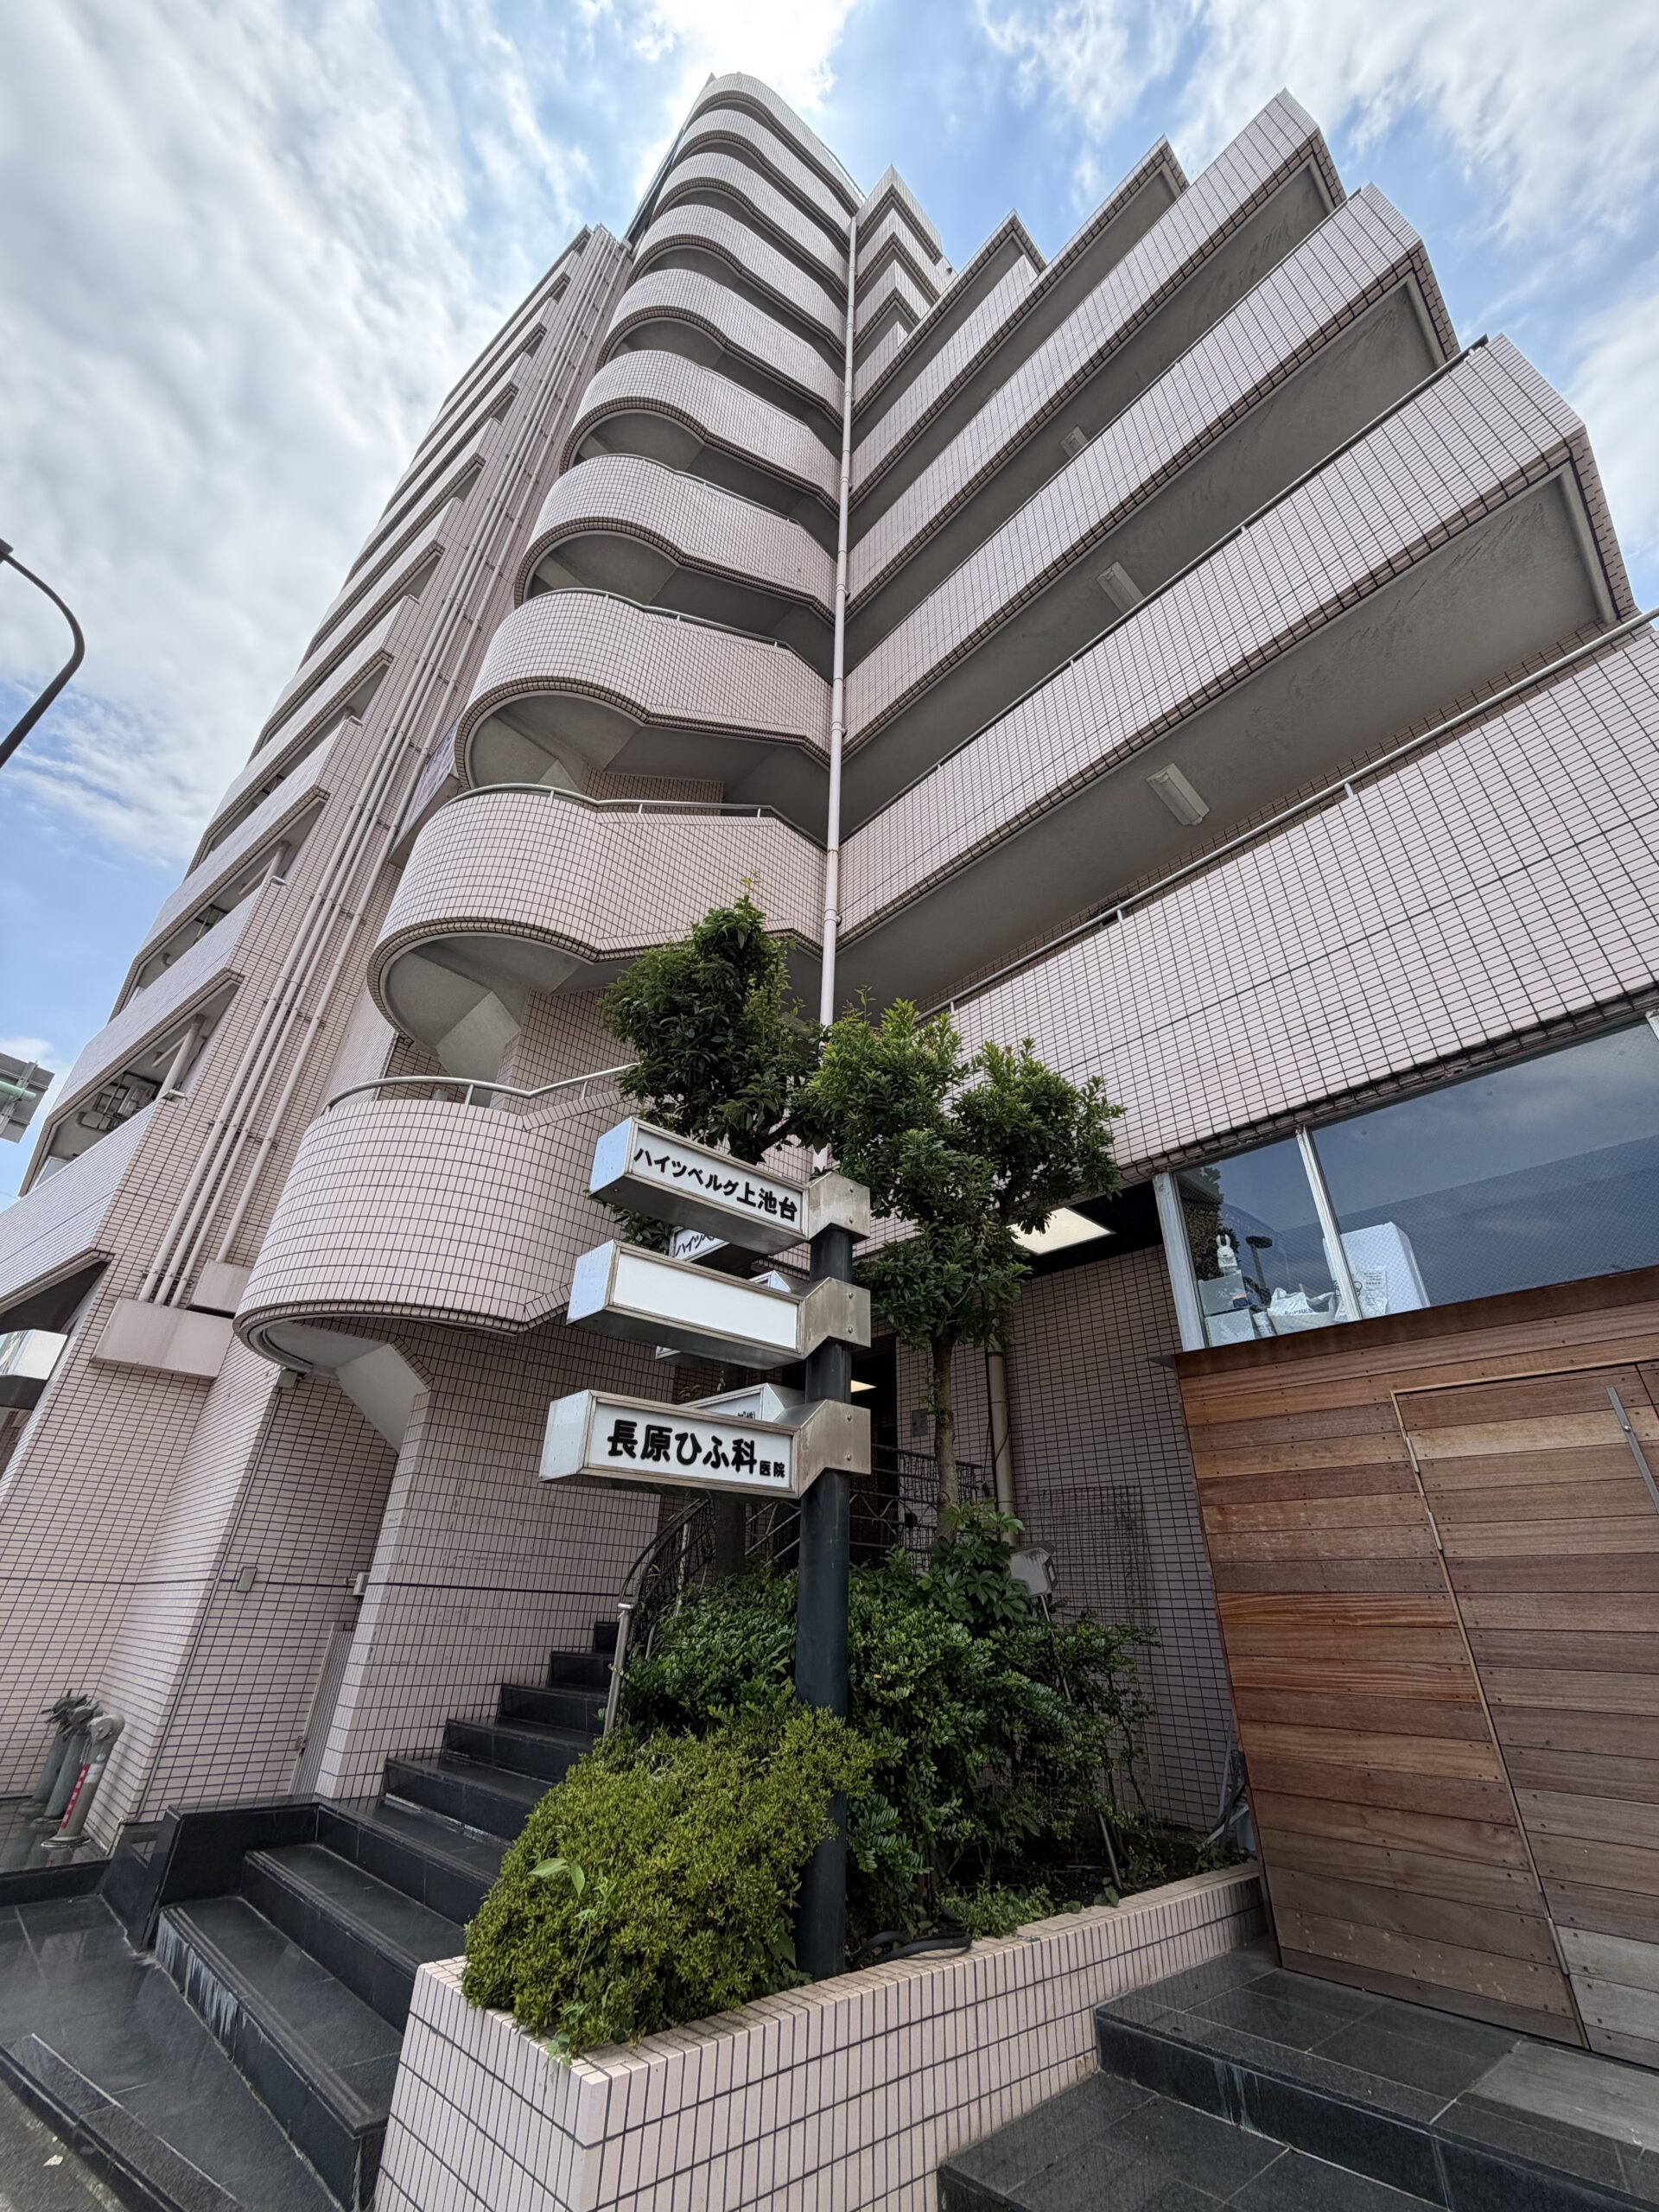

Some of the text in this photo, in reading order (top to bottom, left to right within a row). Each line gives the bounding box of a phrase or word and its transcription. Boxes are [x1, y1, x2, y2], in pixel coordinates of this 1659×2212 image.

[633, 1147, 798, 1223] ハイツベルグ上池台
